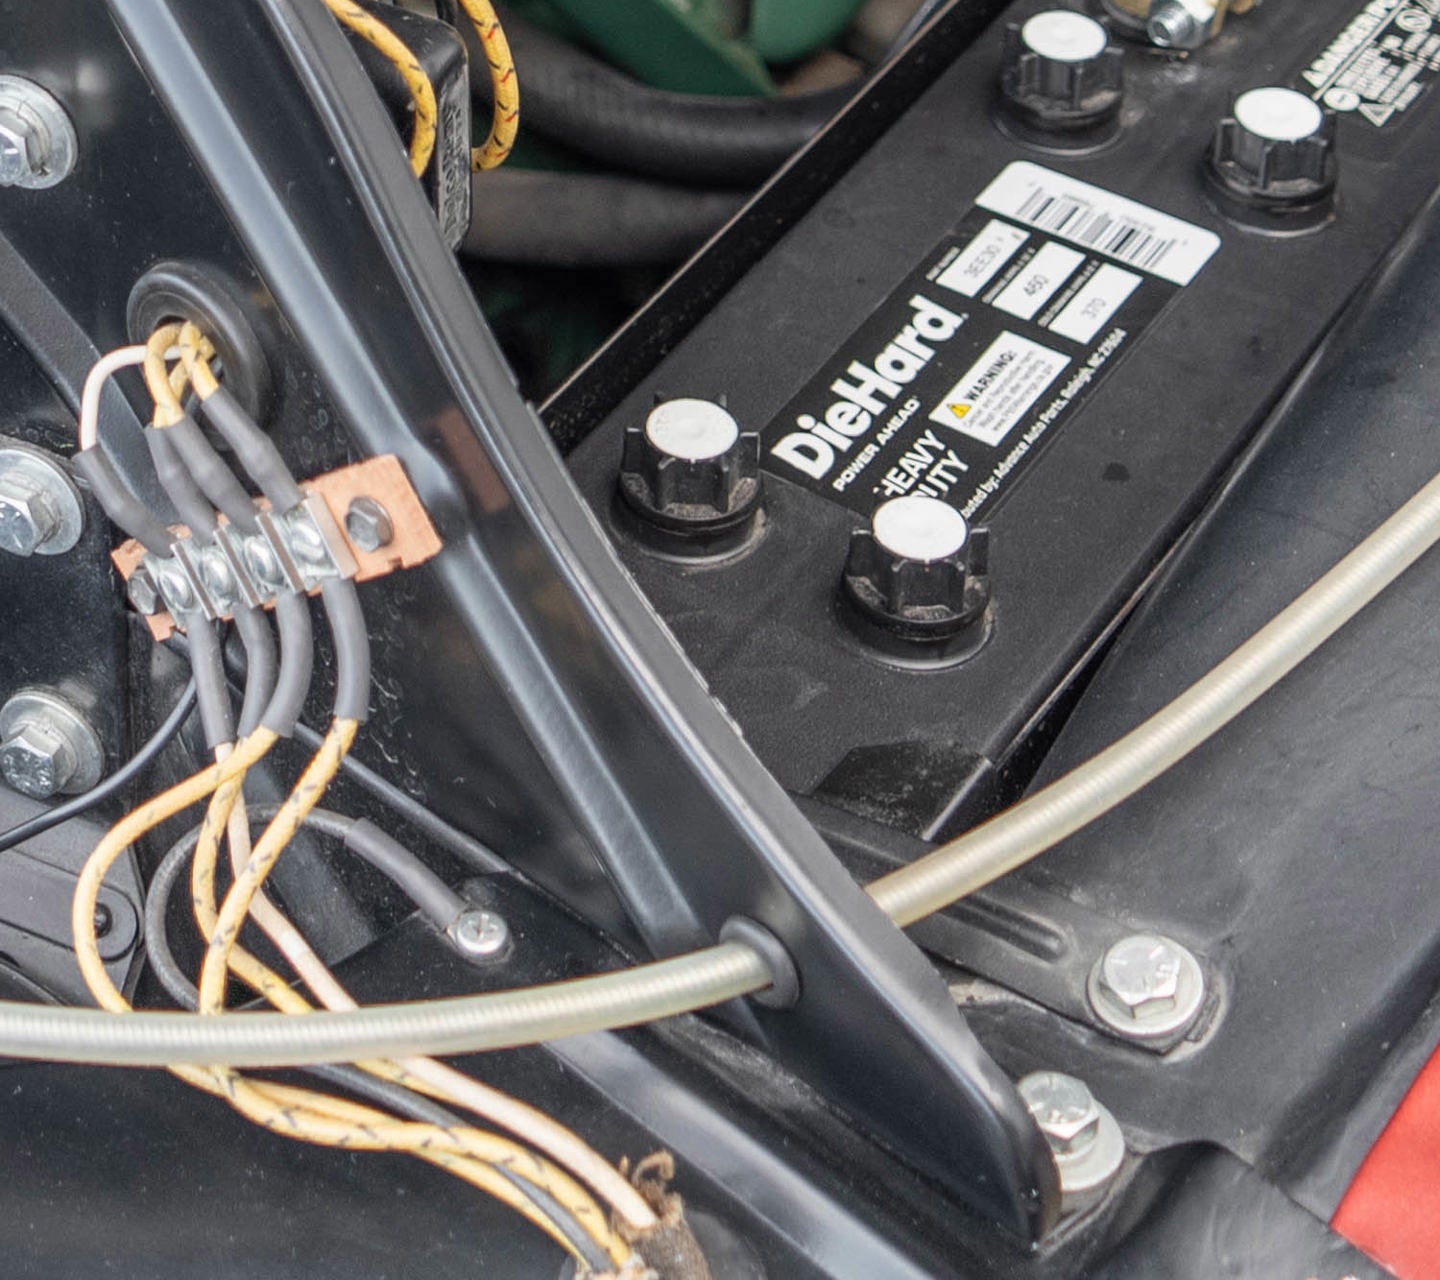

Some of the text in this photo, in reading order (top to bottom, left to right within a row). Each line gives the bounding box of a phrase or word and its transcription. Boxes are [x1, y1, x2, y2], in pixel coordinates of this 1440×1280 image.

[770, 295, 965, 480] DieHard
[833, 397, 920, 492] POWER AHEAD
[873, 429, 946, 496] HEAVY
[993, 441, 1030, 479] Advance
[1023, 421, 1046, 445] Auto
